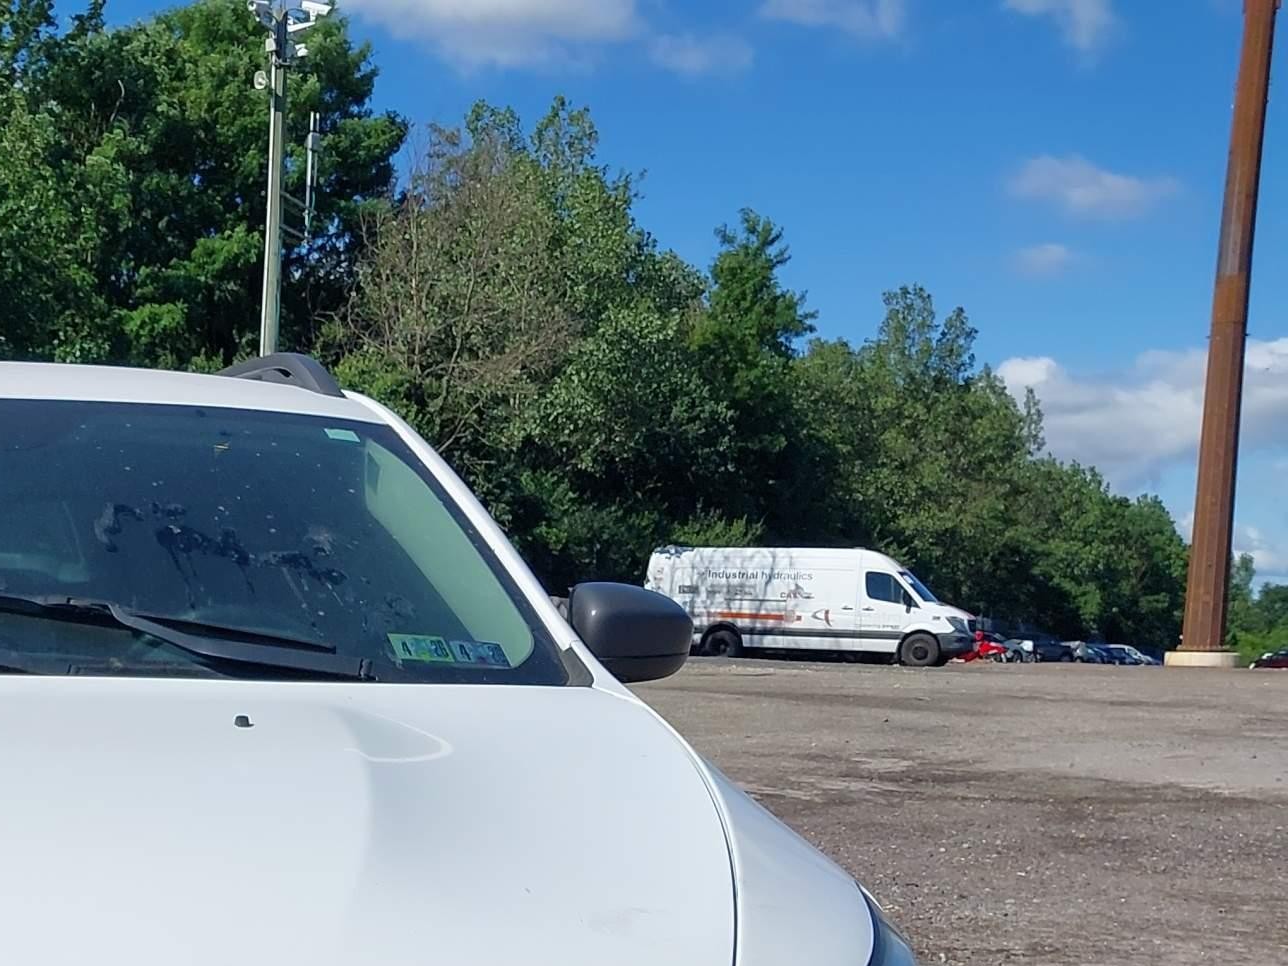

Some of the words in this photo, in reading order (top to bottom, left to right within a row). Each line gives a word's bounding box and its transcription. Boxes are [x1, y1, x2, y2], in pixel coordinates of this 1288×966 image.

[707, 569, 759, 580] Industrial
[761, 570, 814, 582] hydraulics
[401, 641, 412, 656] 4
